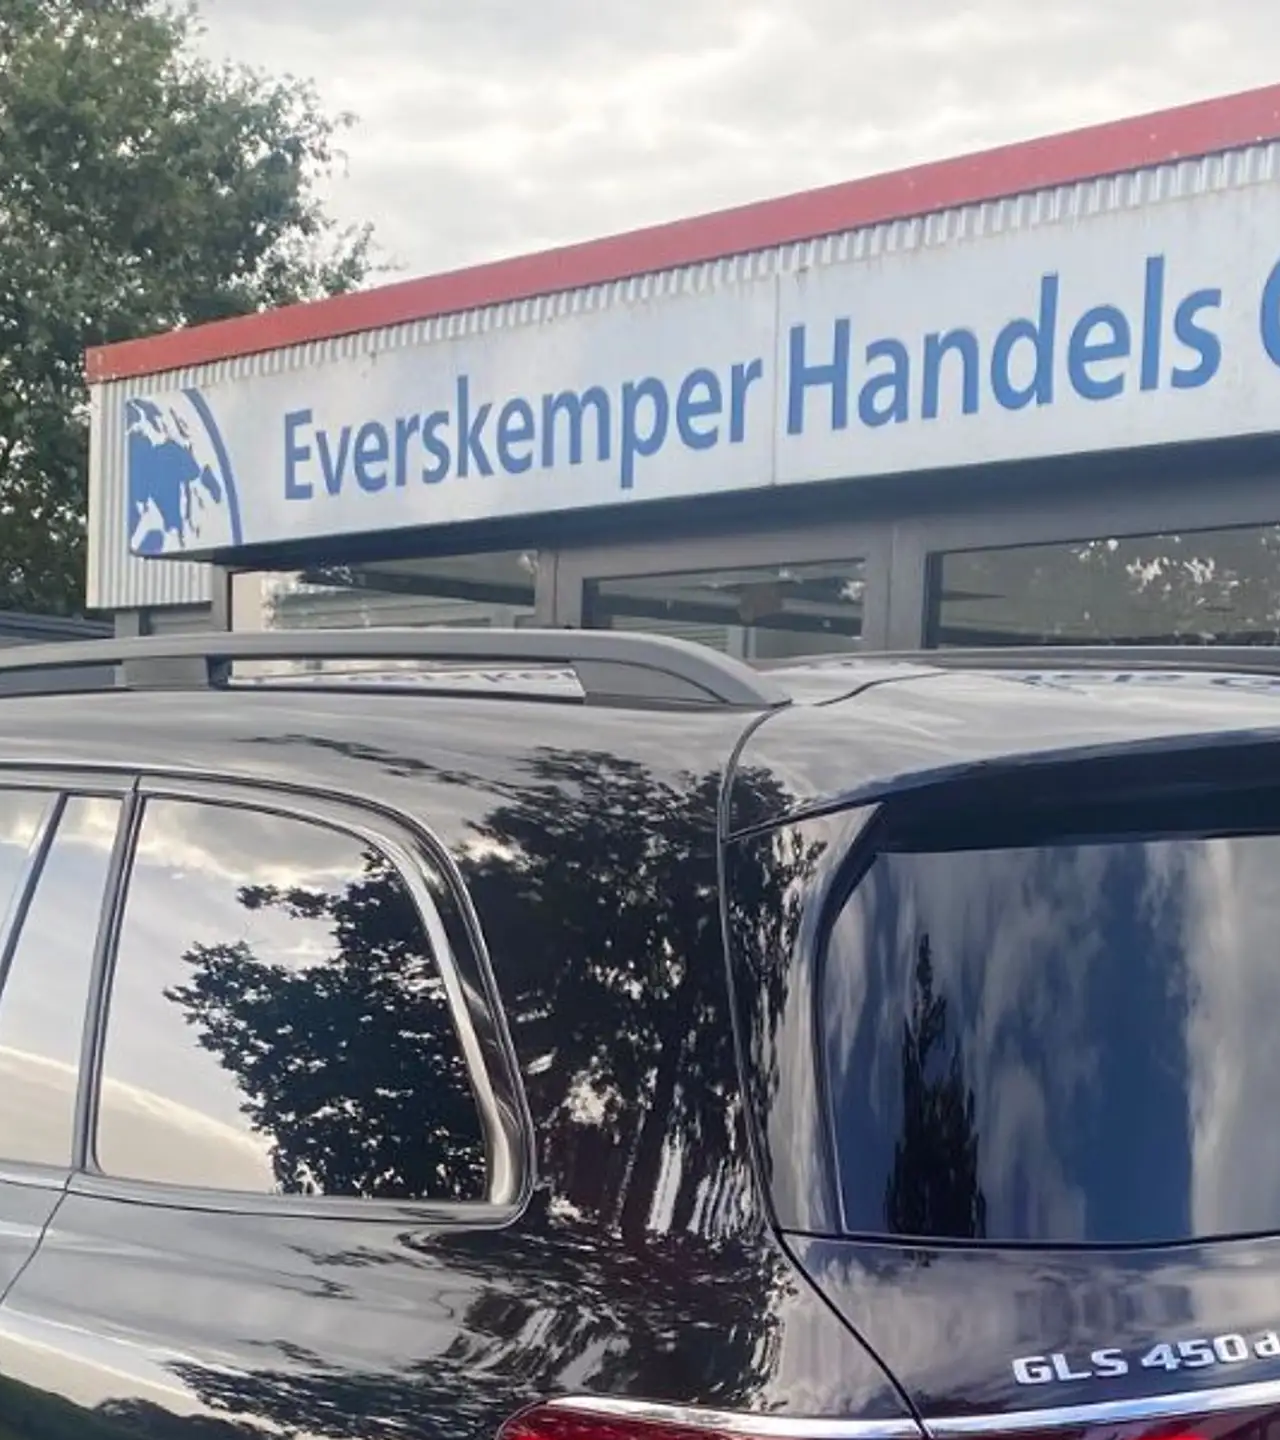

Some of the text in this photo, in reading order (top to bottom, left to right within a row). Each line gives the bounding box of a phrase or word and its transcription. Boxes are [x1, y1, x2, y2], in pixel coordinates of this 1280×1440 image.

[284, 357, 764, 501] Everskemper
[785, 255, 1222, 432] Handels
[1011, 1348, 1130, 1385] GLS
